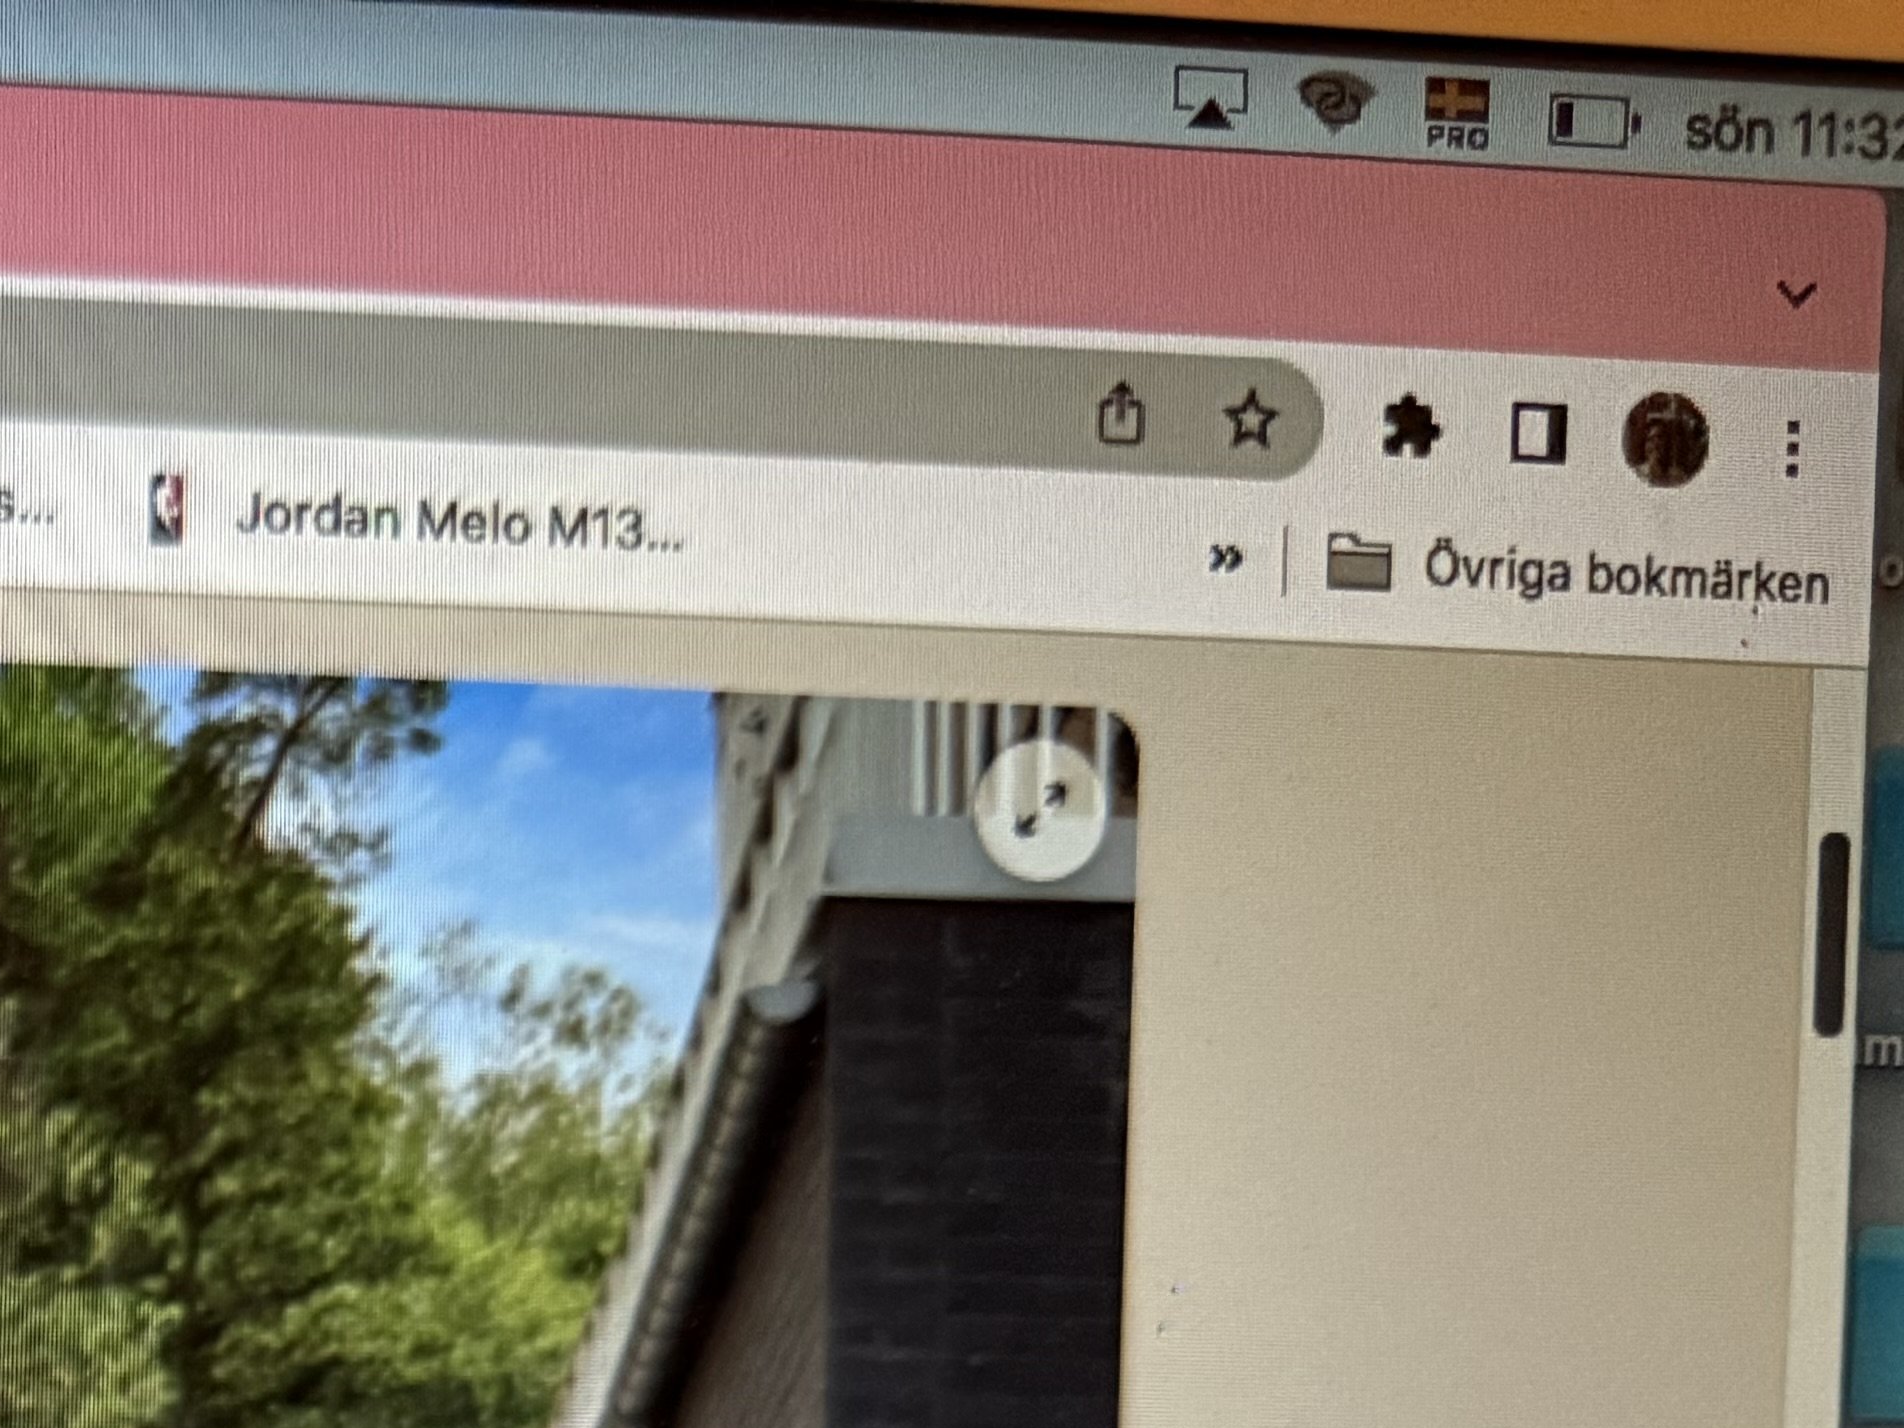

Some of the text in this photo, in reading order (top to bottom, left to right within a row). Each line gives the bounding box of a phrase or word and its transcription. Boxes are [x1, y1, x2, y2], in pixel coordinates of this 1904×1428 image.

[1427, 126, 1489, 151] PRO
[1686, 103, 1775, 155] sön
[236, 491, 685, 554] Jordan Melo M13...
[1425, 536, 1573, 595] Övriga
[1587, 551, 1831, 604] bokmärken
